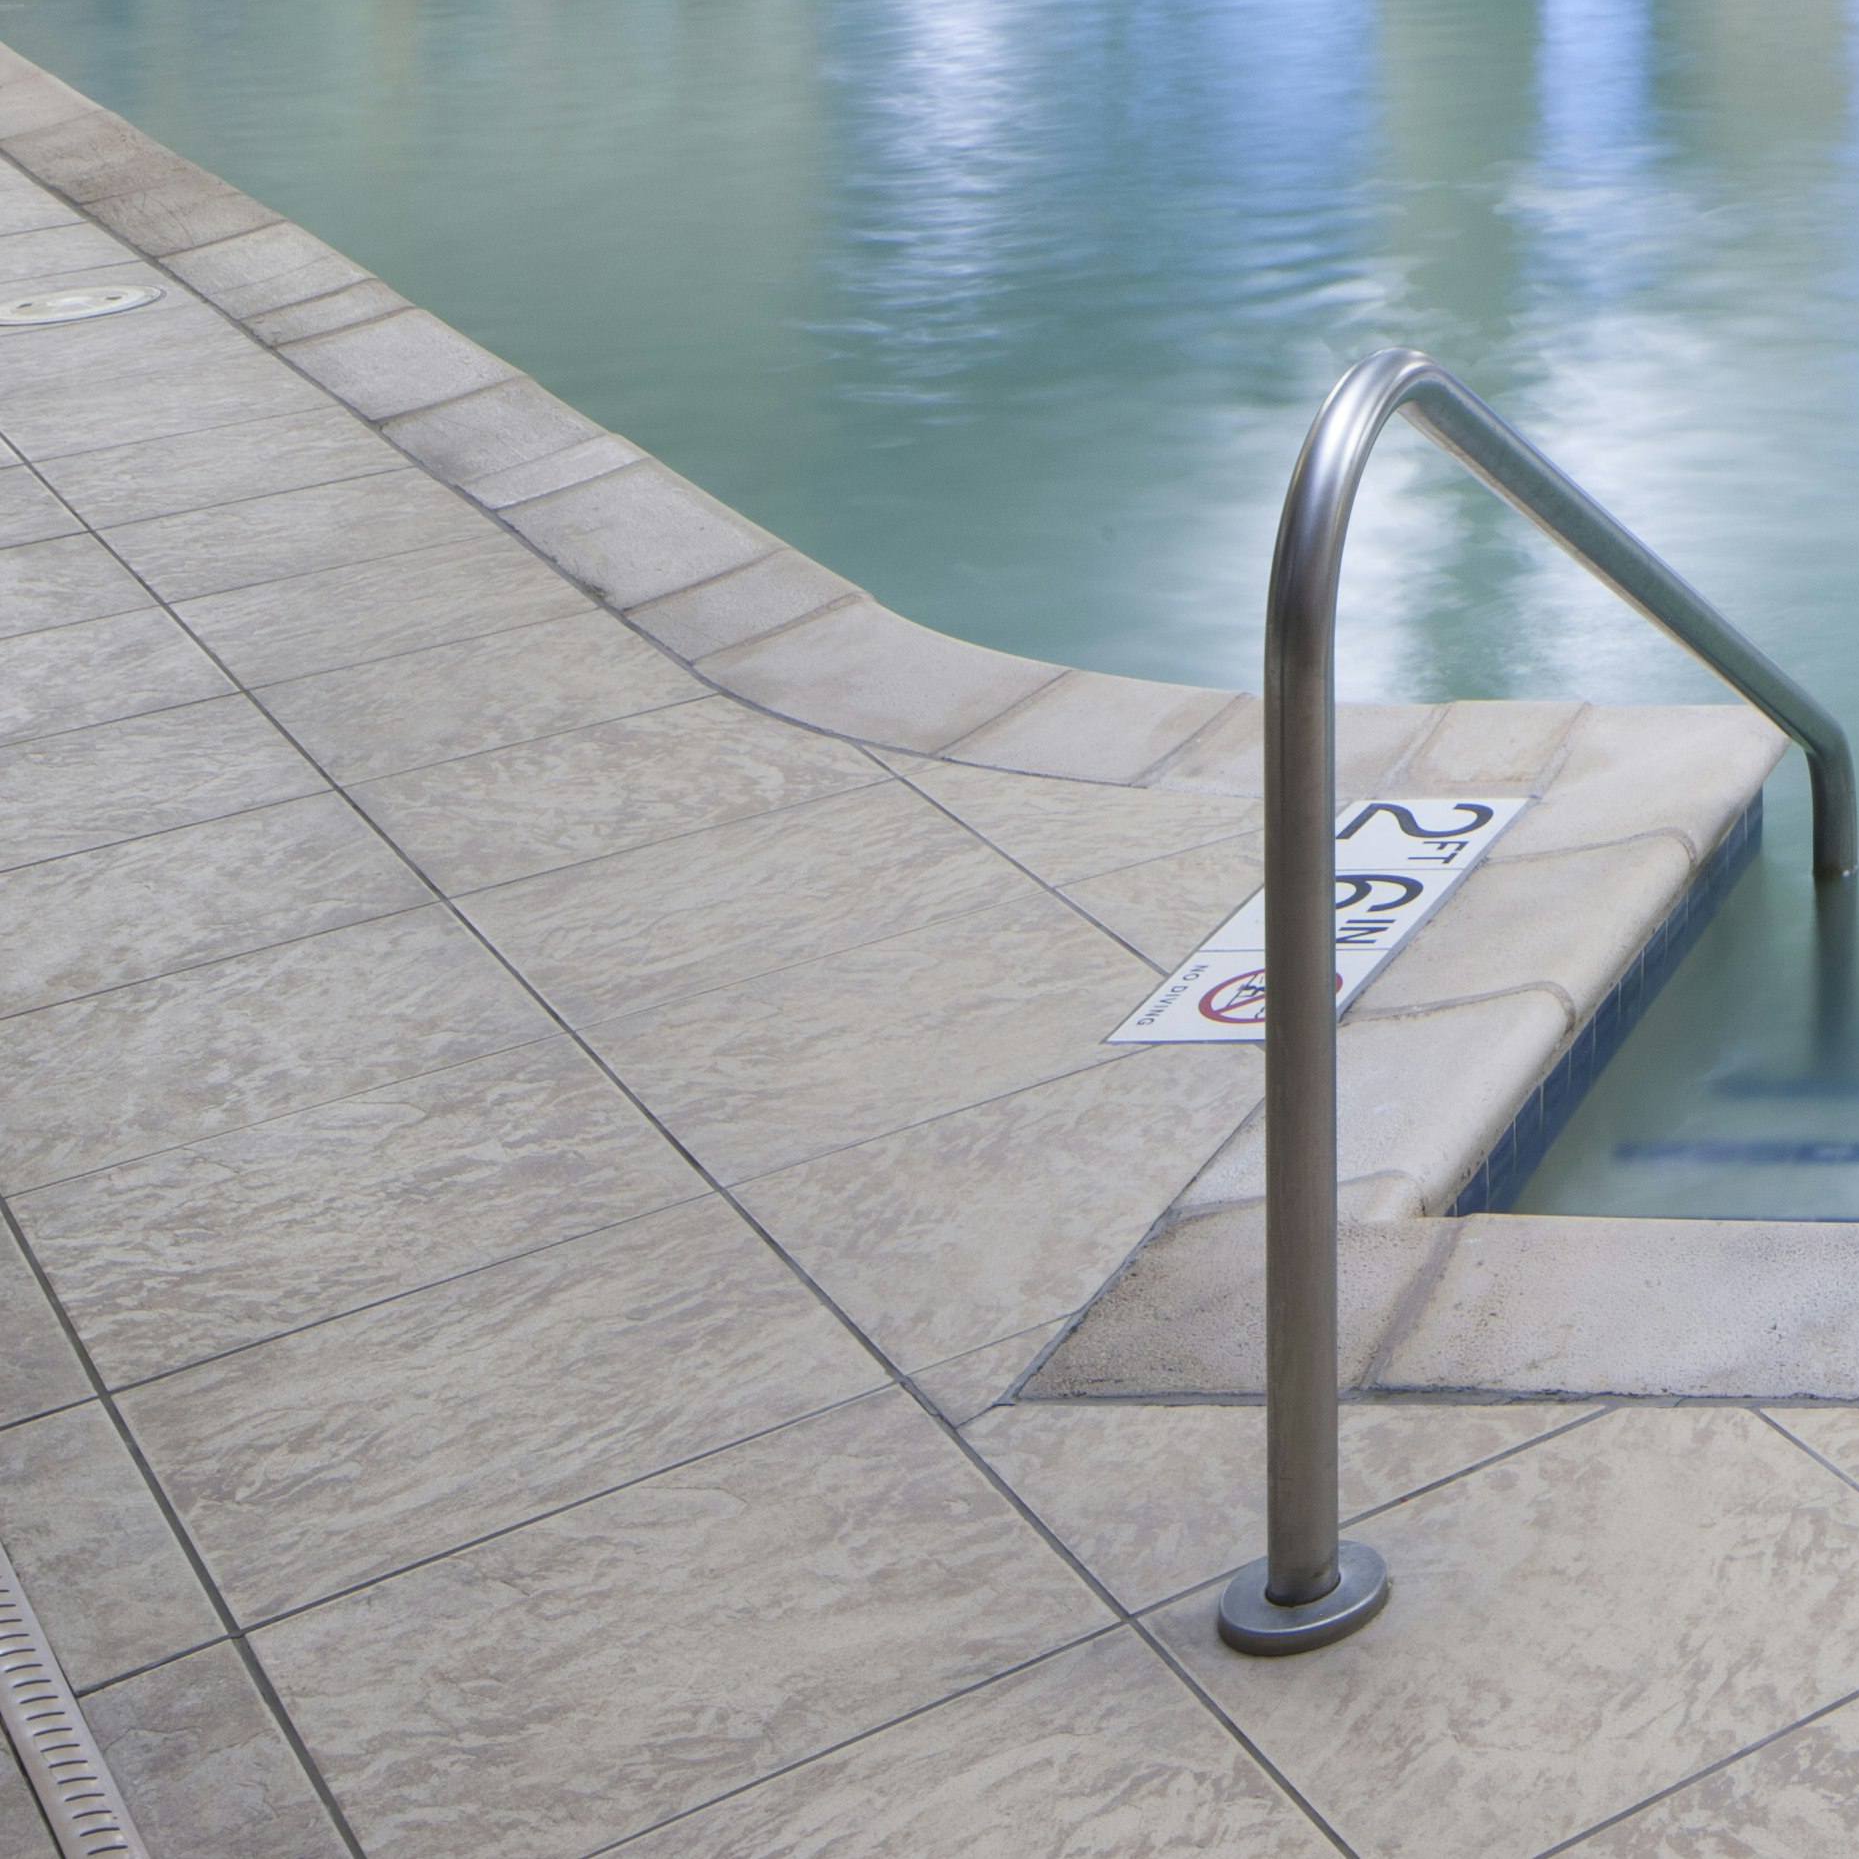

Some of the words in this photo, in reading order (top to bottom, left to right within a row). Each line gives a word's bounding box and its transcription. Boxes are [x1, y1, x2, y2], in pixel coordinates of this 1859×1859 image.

[1335, 802, 1494, 840] 2
[1407, 840, 1470, 865] FT
[1335, 919, 1396, 944] IN
[1182, 964, 1210, 982] NO
[1135, 985, 1189, 1026] DIVING
